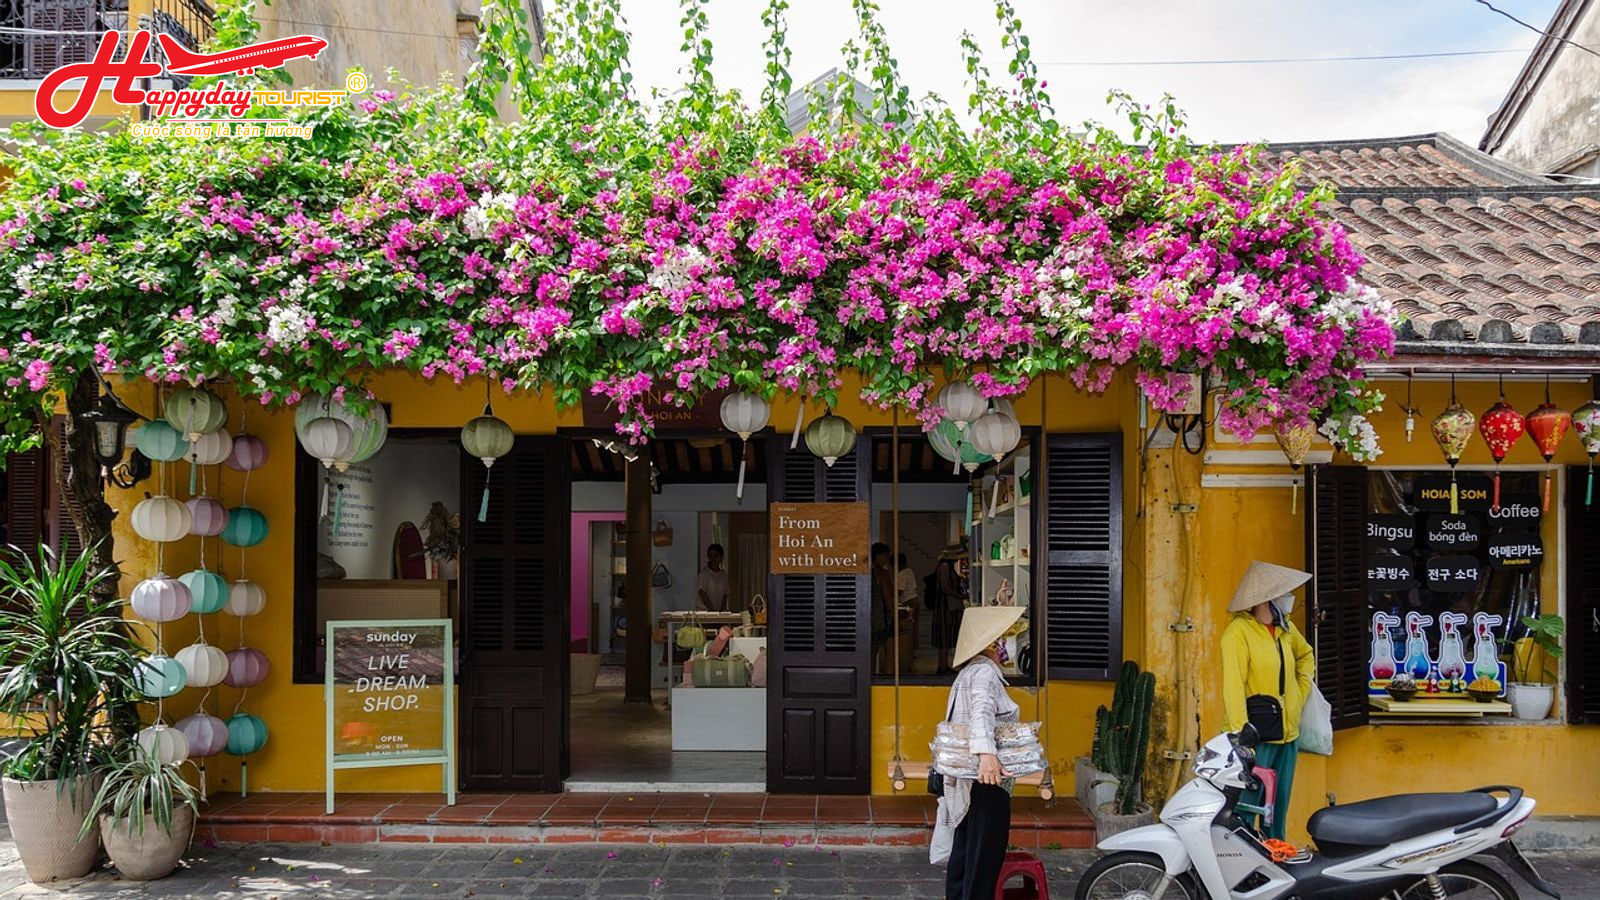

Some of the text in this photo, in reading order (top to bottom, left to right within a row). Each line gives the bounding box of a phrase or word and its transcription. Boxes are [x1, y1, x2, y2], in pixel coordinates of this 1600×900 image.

[674, 412, 691, 420] AN
[1421, 489, 1487, 500] HOIA SOM
[1488, 503, 1540, 519] Coffee
[778, 516, 820, 529] From
[1441, 520, 1467, 530] Soda
[1367, 522, 1413, 541] Bingsu
[1429, 531, 1478, 544] bóng đèn
[778, 535, 833, 548] Hoi An
[1488, 544, 1544, 558] 아메리카노
[778, 554, 857, 567] with love!
[1428, 568, 1479, 581] 전구 소다
[366, 631, 417, 645] sunday
[367, 654, 410, 670] LIVE
[363, 694, 419, 713] SHOP.
[380, 735, 404, 743] OPEN
